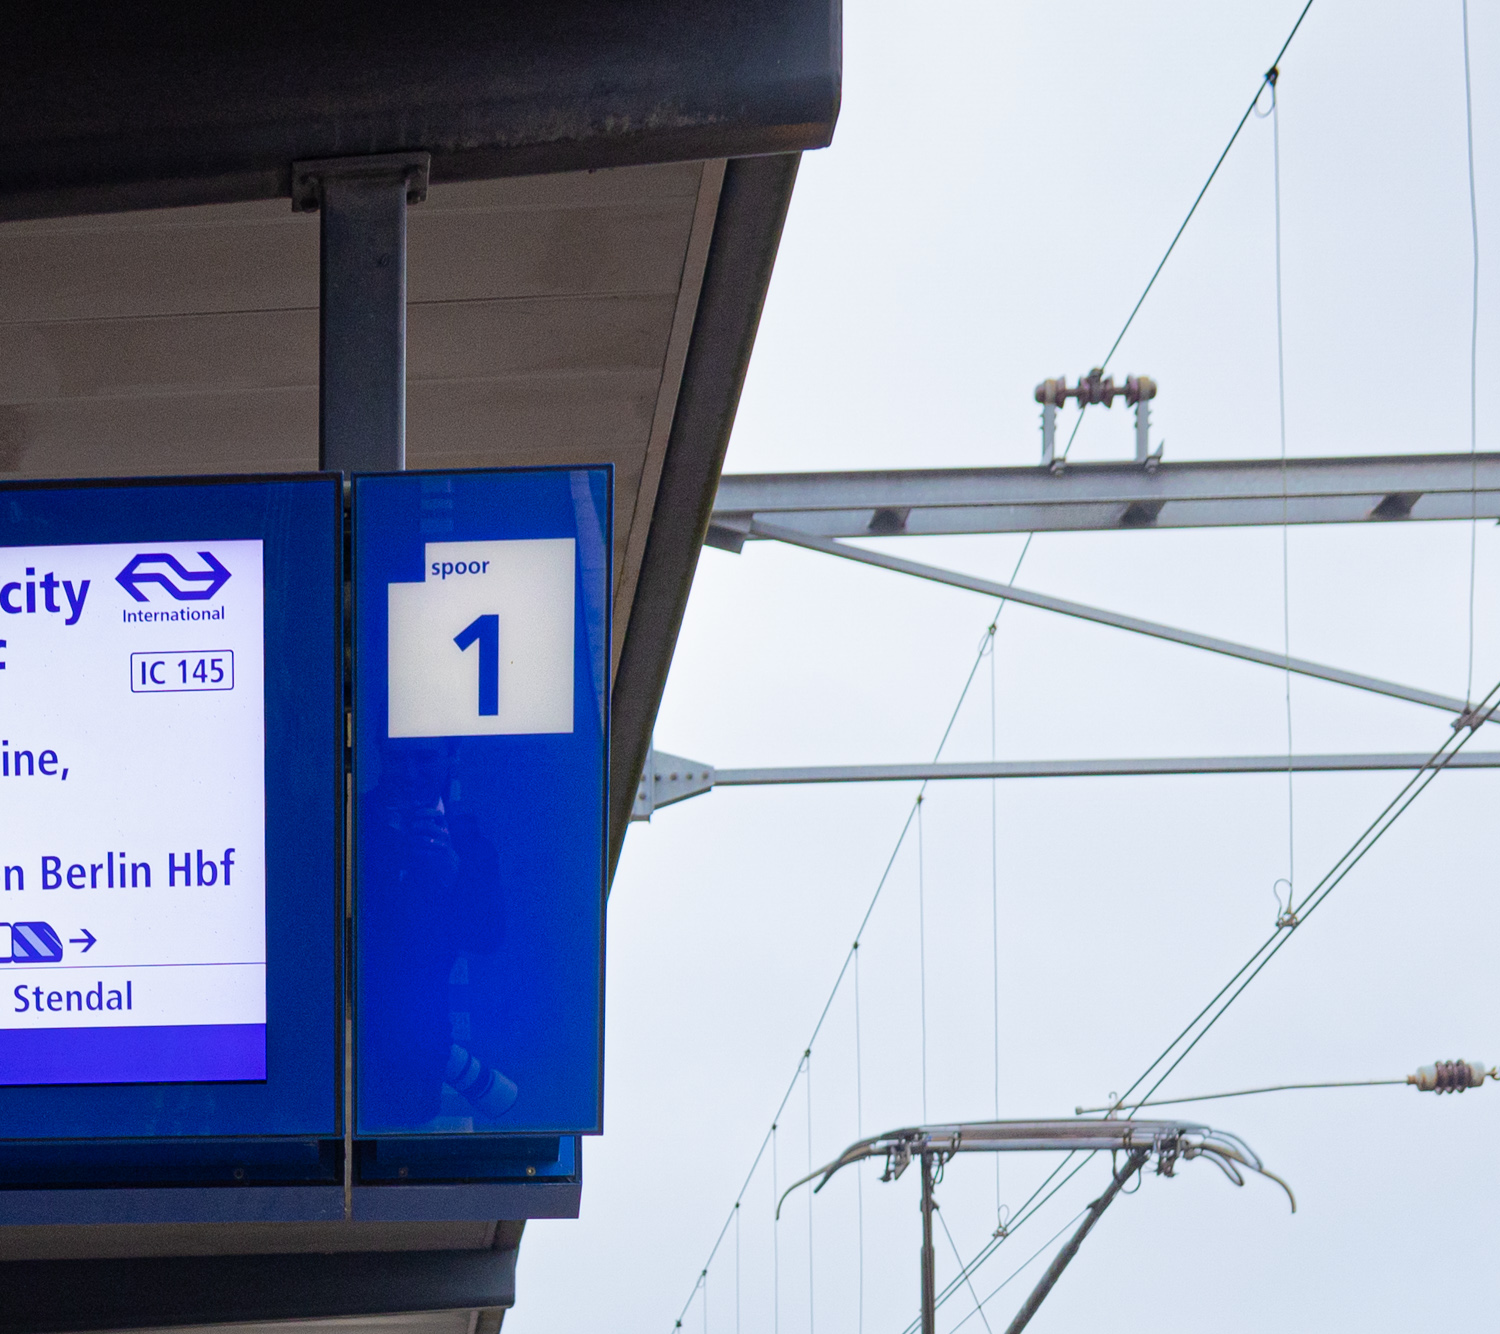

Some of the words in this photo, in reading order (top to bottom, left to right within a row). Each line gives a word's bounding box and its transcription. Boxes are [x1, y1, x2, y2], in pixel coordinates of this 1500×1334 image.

[431, 560, 490, 580] spoor
[123, 606, 224, 622] International
[142, 661, 165, 685] IC
[178, 659, 224, 684] 145
[453, 614, 499, 717] 1
[42, 852, 151, 890] Berlin
[169, 848, 235, 887] Hbf
[14, 981, 132, 1012] Stendal
